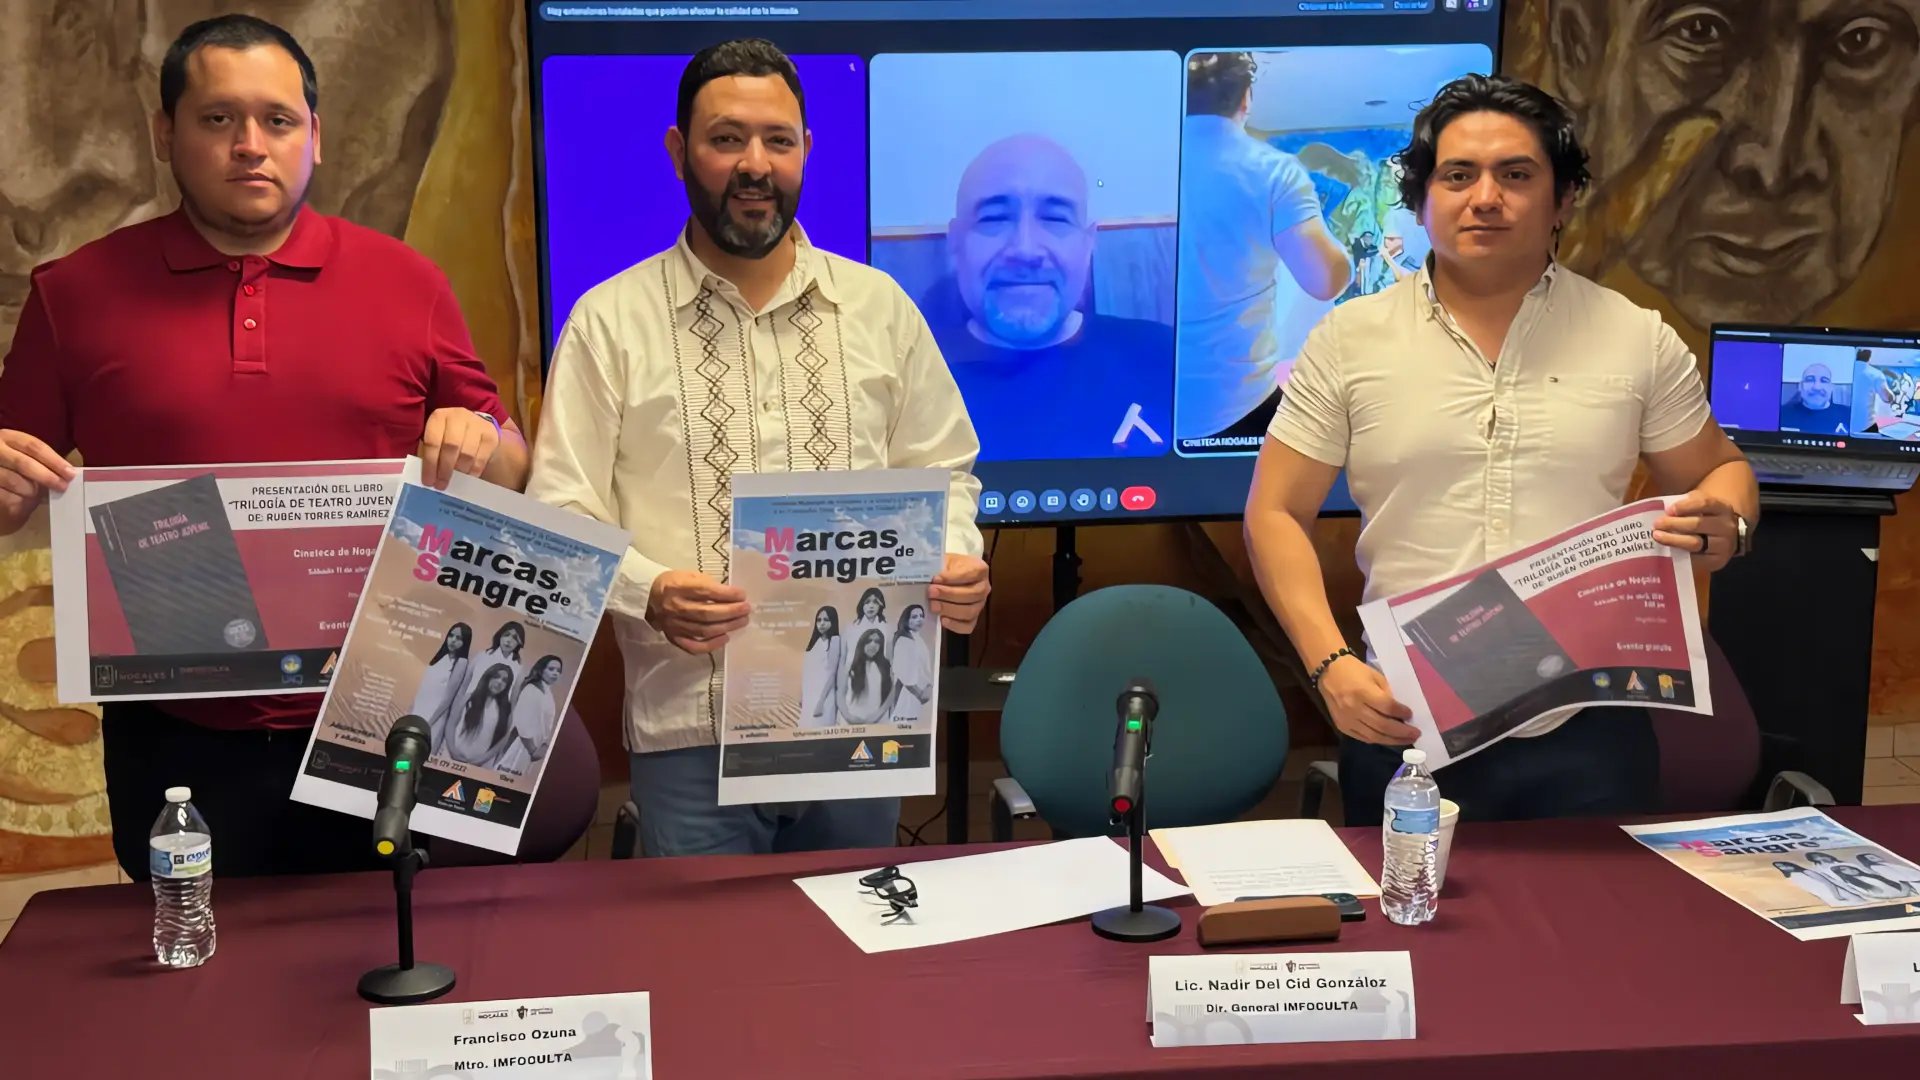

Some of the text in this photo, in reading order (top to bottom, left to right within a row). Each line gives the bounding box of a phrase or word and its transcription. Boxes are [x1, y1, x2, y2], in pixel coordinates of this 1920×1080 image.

[252, 483, 383, 495] PRESENTACIÓN DEL LIBRO
[290, 498, 305, 508] DE
[308, 497, 352, 508] TEATRO
[266, 511, 301, 521] RUBÉN
[304, 510, 344, 521] TORRES
[346, 509, 389, 519] RAMÍREZ
[764, 526, 899, 554] Marcas
[293, 549, 335, 558] Cineteca
[338, 547, 350, 556] de
[416, 523, 559, 591] Marcas
[894, 545, 915, 558] de
[1529, 534, 1594, 571] PRESENTACIÓN
[1595, 530, 1614, 542] DEL
[1563, 553, 1577, 565] DE
[1579, 538, 1618, 557] TEATRO
[766, 553, 896, 584] Sangre
[412, 552, 548, 615] Sangre
[549, 591, 571, 607] de
[1175, 979, 1203, 991] Lic.
[1208, 978, 1250, 991] Nadir
[1255, 978, 1280, 990] Del
[1285, 977, 1311, 989] Cid
[1206, 1003, 1228, 1013] Dir.
[1283, 1001, 1359, 1012] IMFOCULTA
[453, 1028, 577, 1046] Francisco Ozuna
[454, 1060, 489, 1071] Mtro.
